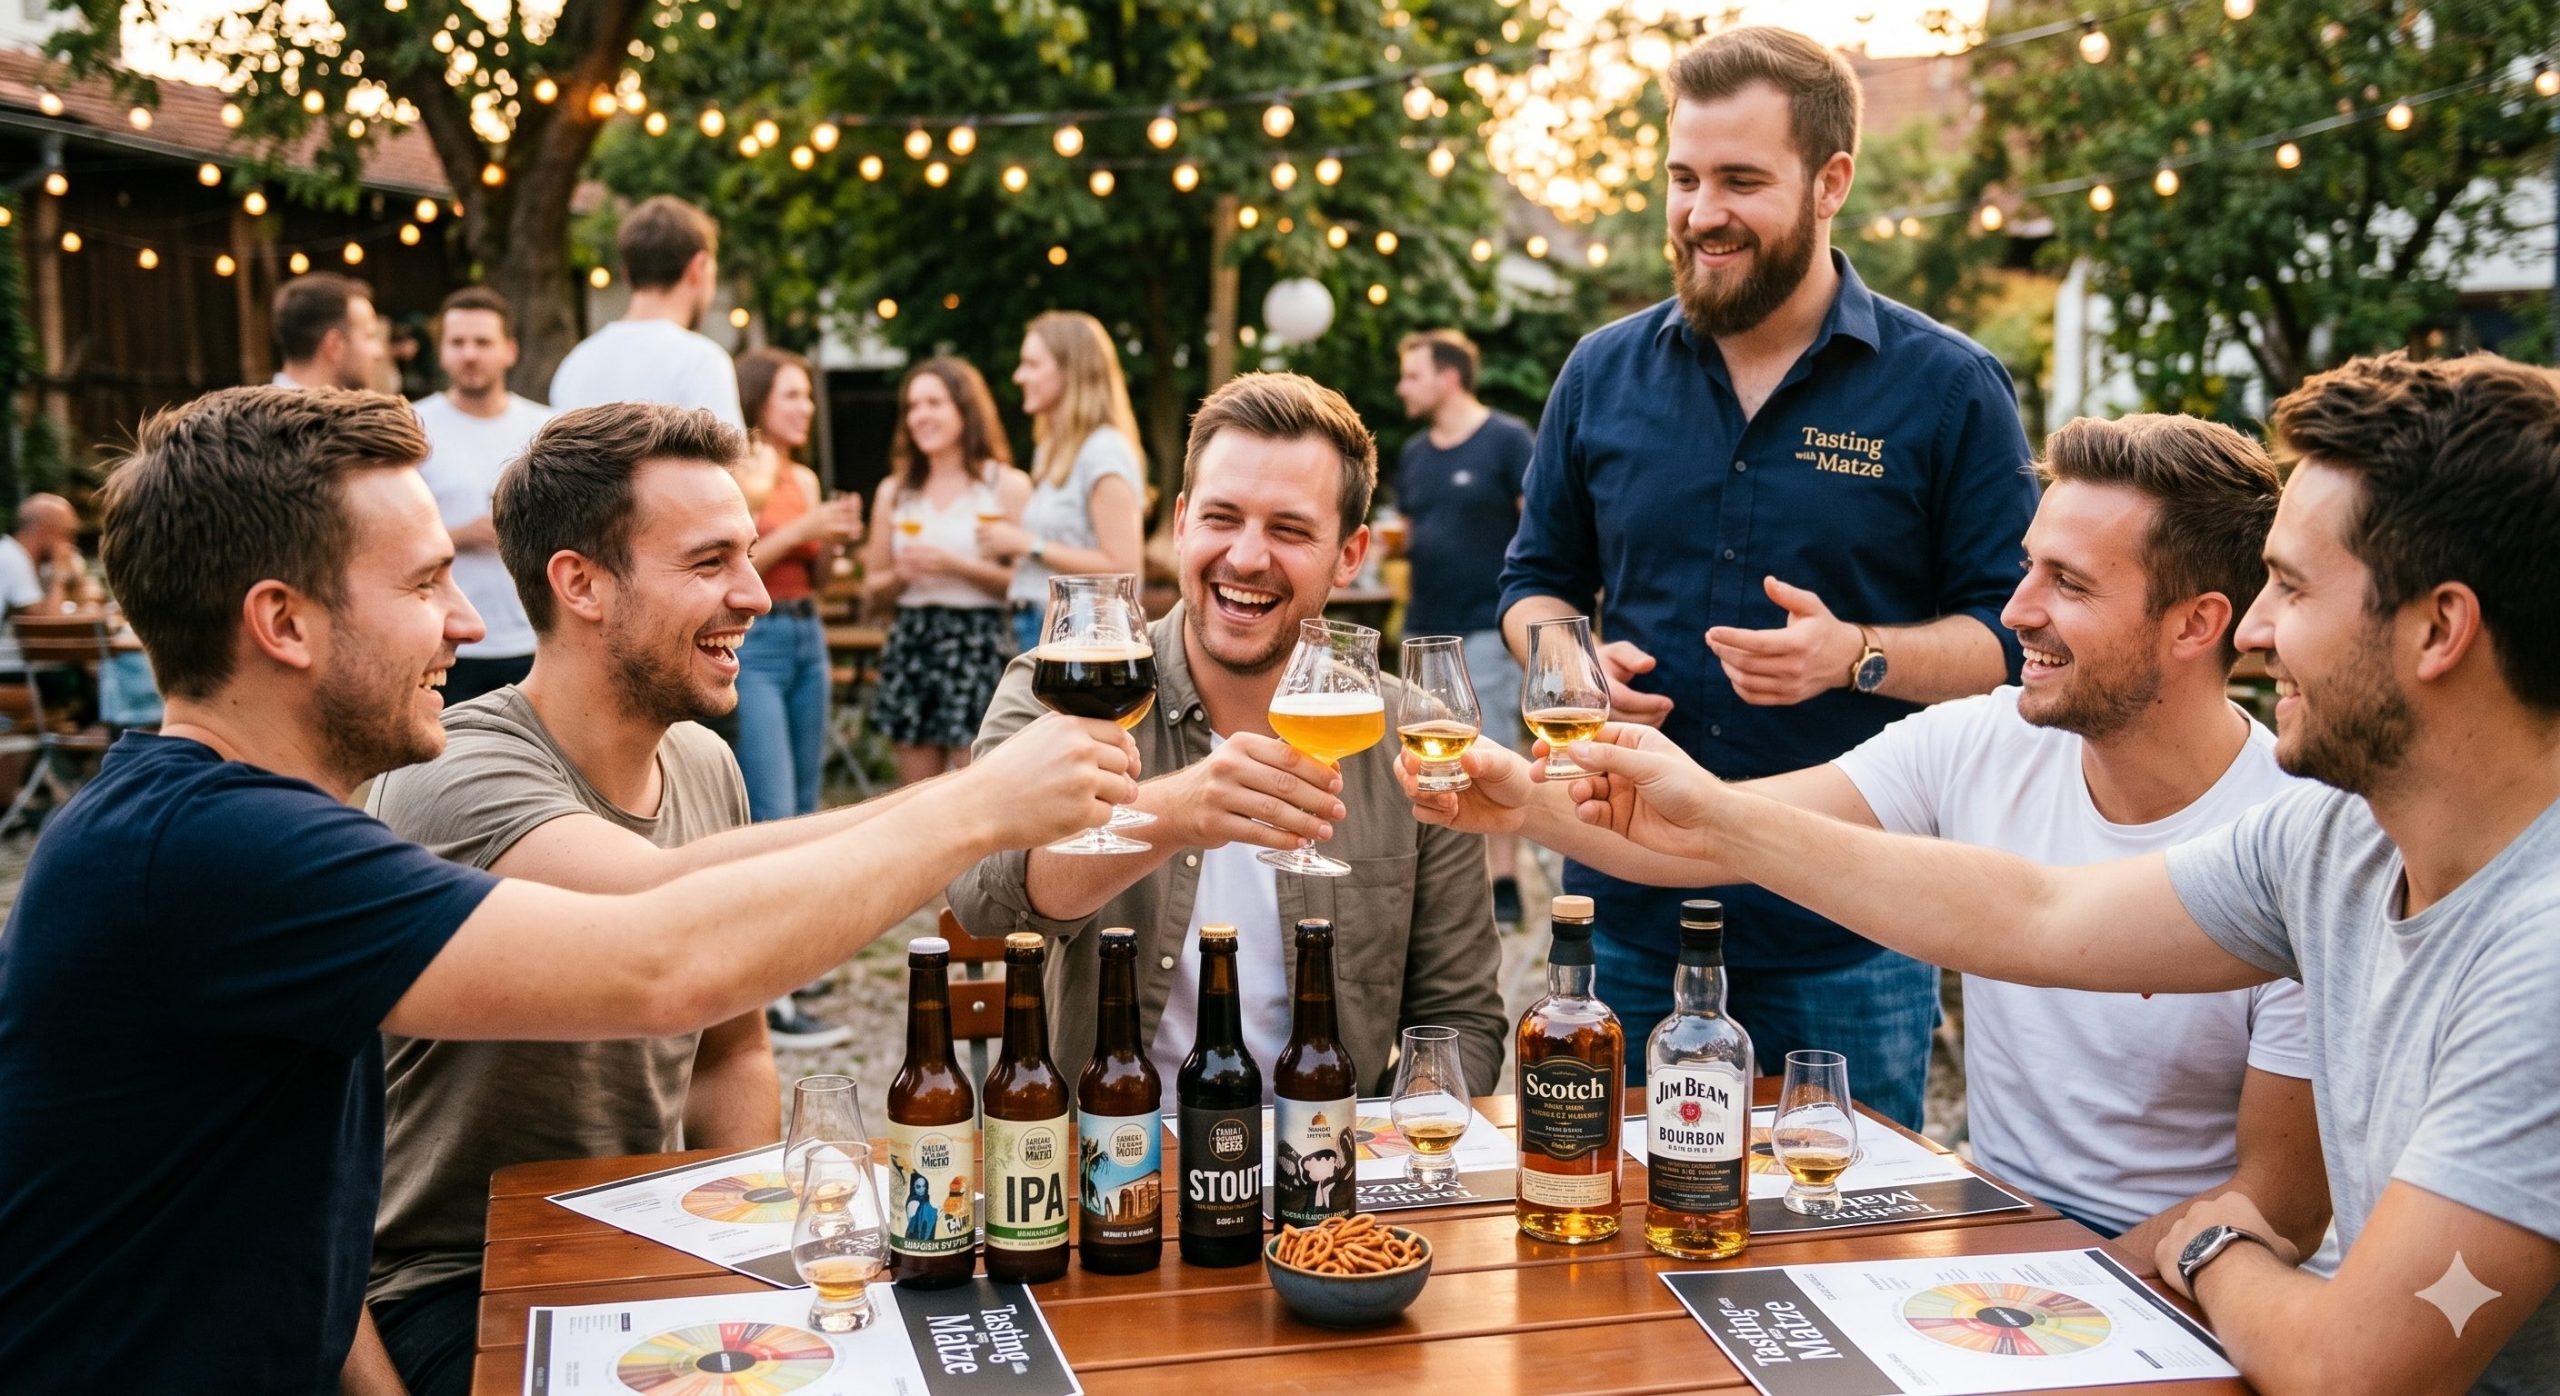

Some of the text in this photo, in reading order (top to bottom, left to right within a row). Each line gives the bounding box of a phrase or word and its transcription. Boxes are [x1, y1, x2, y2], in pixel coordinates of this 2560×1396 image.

[1795, 451, 1885, 478] with Matze
[1802, 426, 1885, 460] Tasting
[1526, 1072, 1605, 1100] Scotch
[1659, 1126, 1725, 1146] BOURBON
[1006, 1172, 1065, 1223] IPA
[1189, 1163, 1262, 1203] STOUT
[926, 1313, 980, 1375] Matze
[980, 1304, 1030, 1364] Tasting
[1719, 1308, 1792, 1367] Tasting
[1764, 1301, 1844, 1360] Matze
